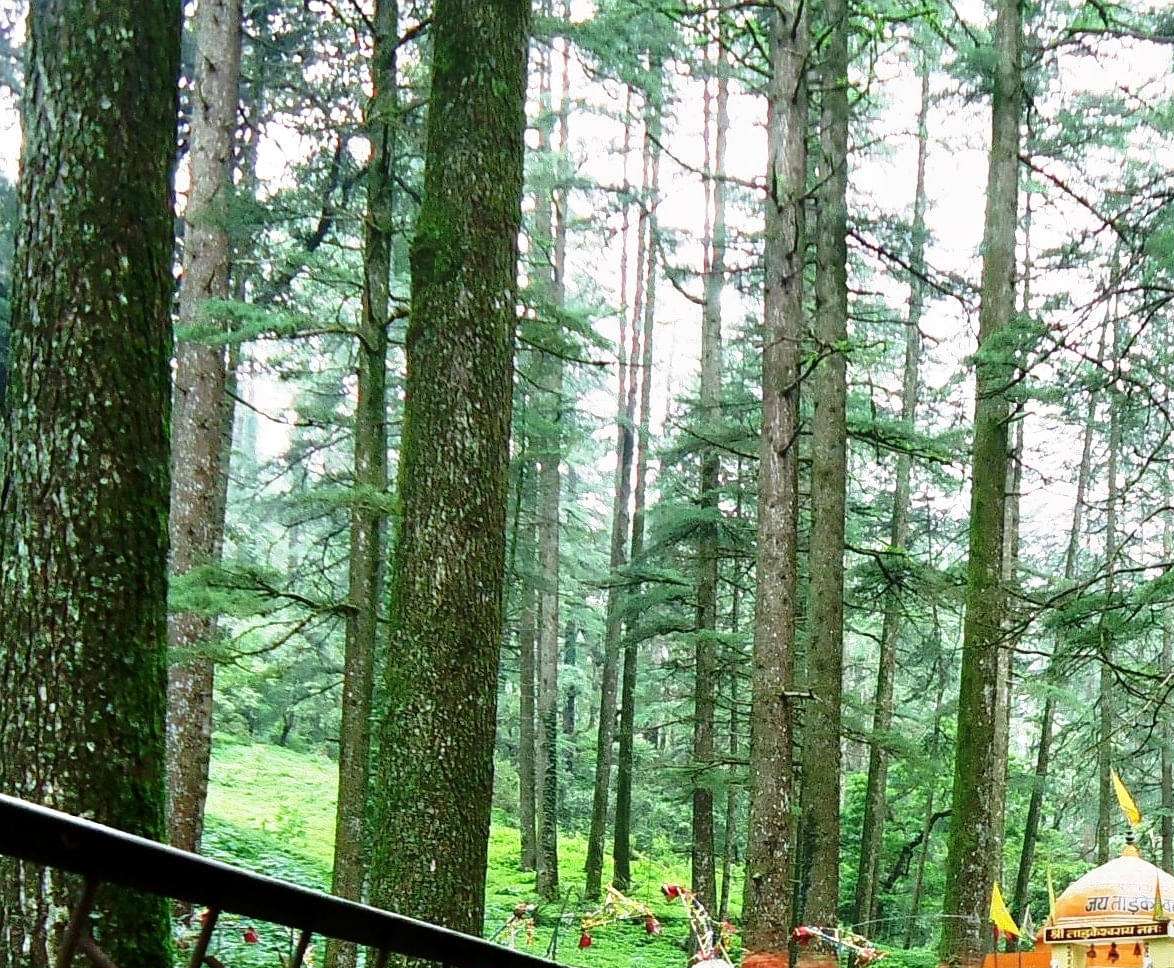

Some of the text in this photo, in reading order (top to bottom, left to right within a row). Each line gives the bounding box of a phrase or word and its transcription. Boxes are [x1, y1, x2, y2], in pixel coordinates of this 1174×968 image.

[1085, 896, 1109, 912] जय
[1050, 927, 1064, 940] श्री
[1137, 924, 1162, 935] नमः
